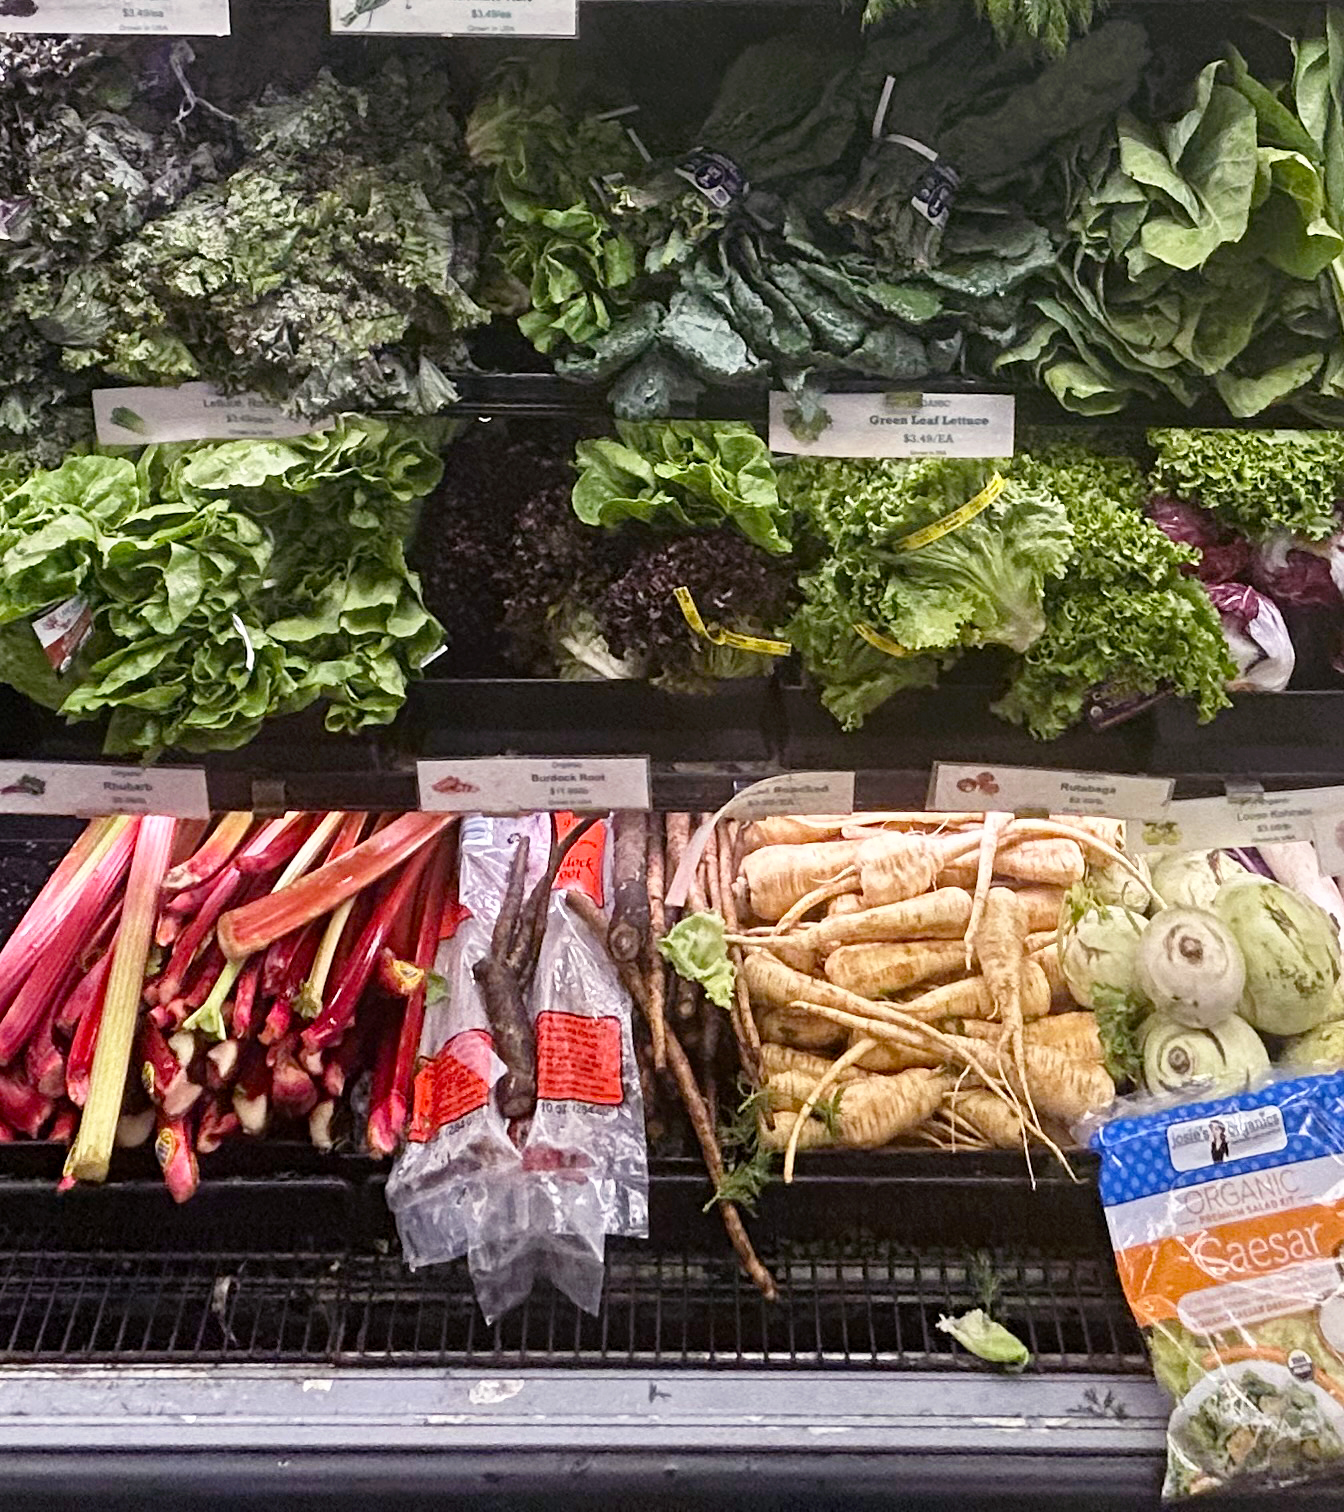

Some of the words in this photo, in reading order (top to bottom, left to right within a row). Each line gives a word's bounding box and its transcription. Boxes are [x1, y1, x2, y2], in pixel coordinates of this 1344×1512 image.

[869, 415, 909, 426] Green
[911, 415, 939, 426] Leaf
[941, 415, 990, 426] Lettuce
[531, 773, 577, 783] Burdock
[579, 773, 607, 782] Root
[1183, 1169, 1300, 1215] ORGANIC
[1196, 1220, 1324, 1273] Caesar
